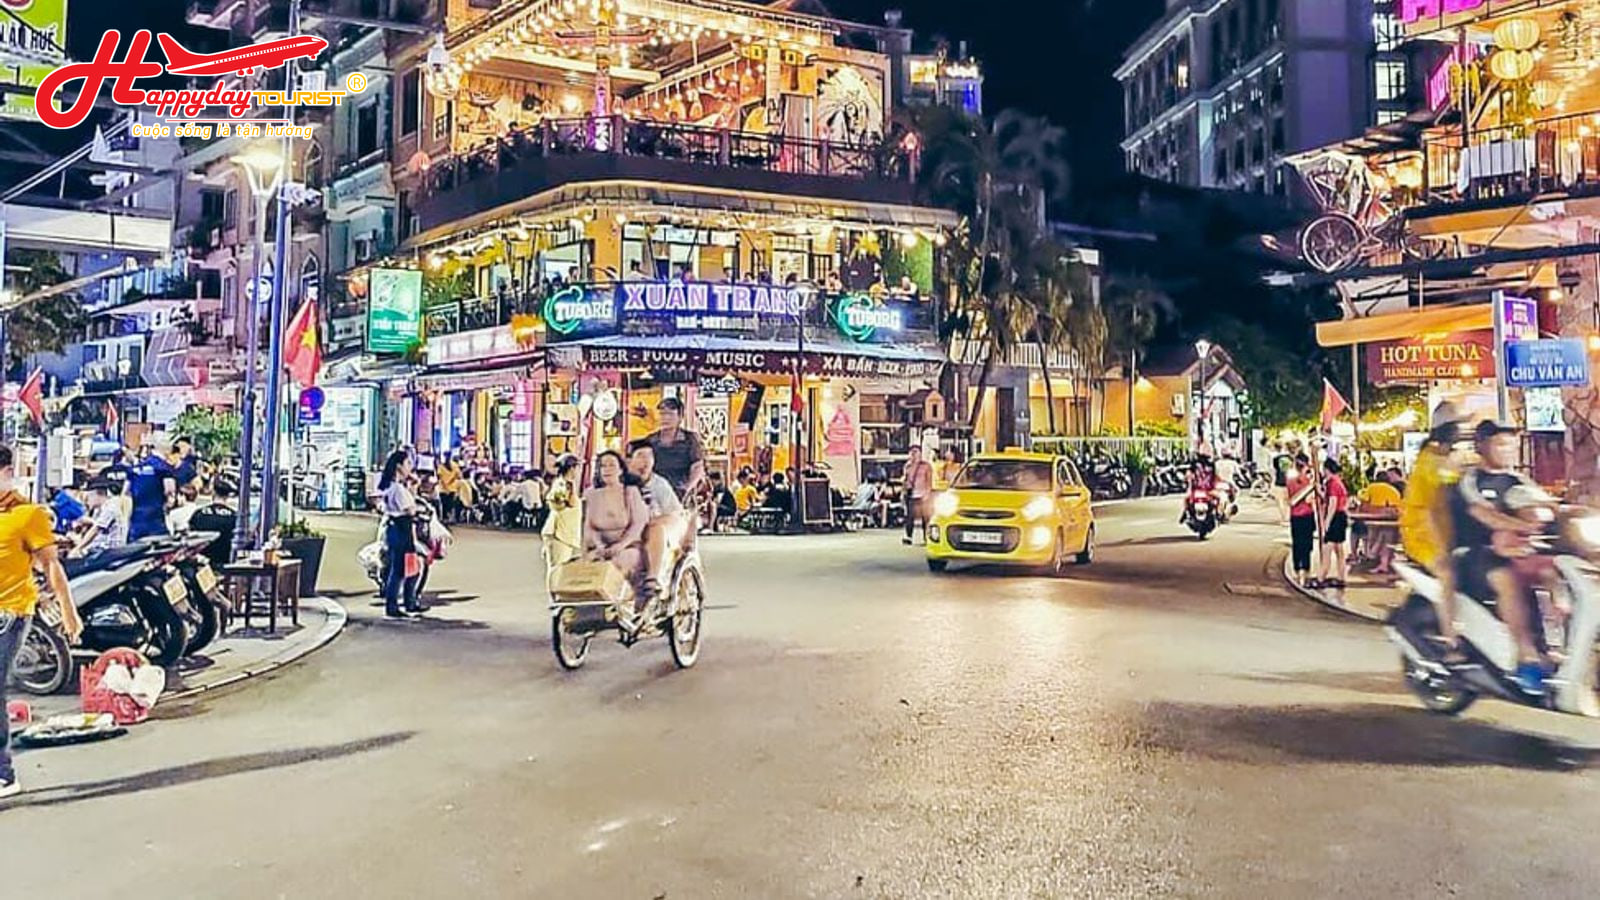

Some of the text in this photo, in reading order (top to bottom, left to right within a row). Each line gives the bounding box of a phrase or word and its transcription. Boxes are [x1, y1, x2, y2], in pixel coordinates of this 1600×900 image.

[623, 279, 708, 310] XUÂN
[554, 300, 613, 321] TUBORG
[589, 350, 629, 362] BEER
[705, 351, 765, 367] MUSIC
[1381, 343, 1481, 364] HOT TUNA
[1384, 366, 1435, 377] HANDMADE
[1511, 366, 1536, 381] CHU
[1566, 363, 1583, 380] AN
